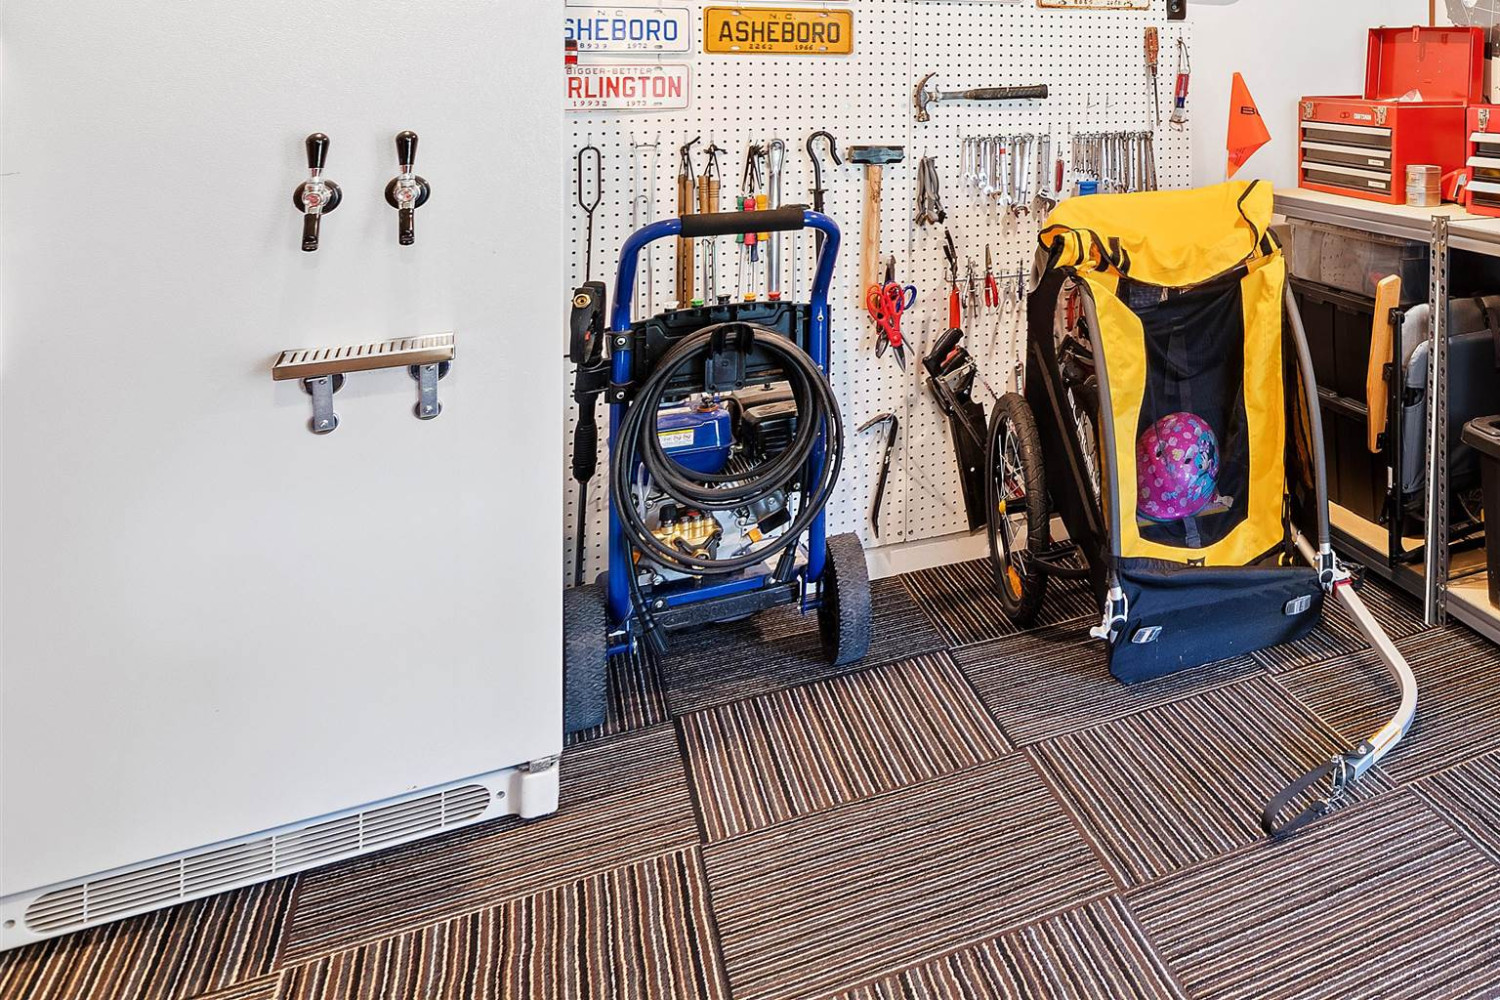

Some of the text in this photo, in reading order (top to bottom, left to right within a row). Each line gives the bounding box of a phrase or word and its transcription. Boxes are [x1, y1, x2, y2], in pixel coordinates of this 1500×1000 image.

[565, 18, 678, 41] SHEBORO
[719, 20, 840, 43] ASHEBORO
[568, 76, 682, 98] RLINGTON
